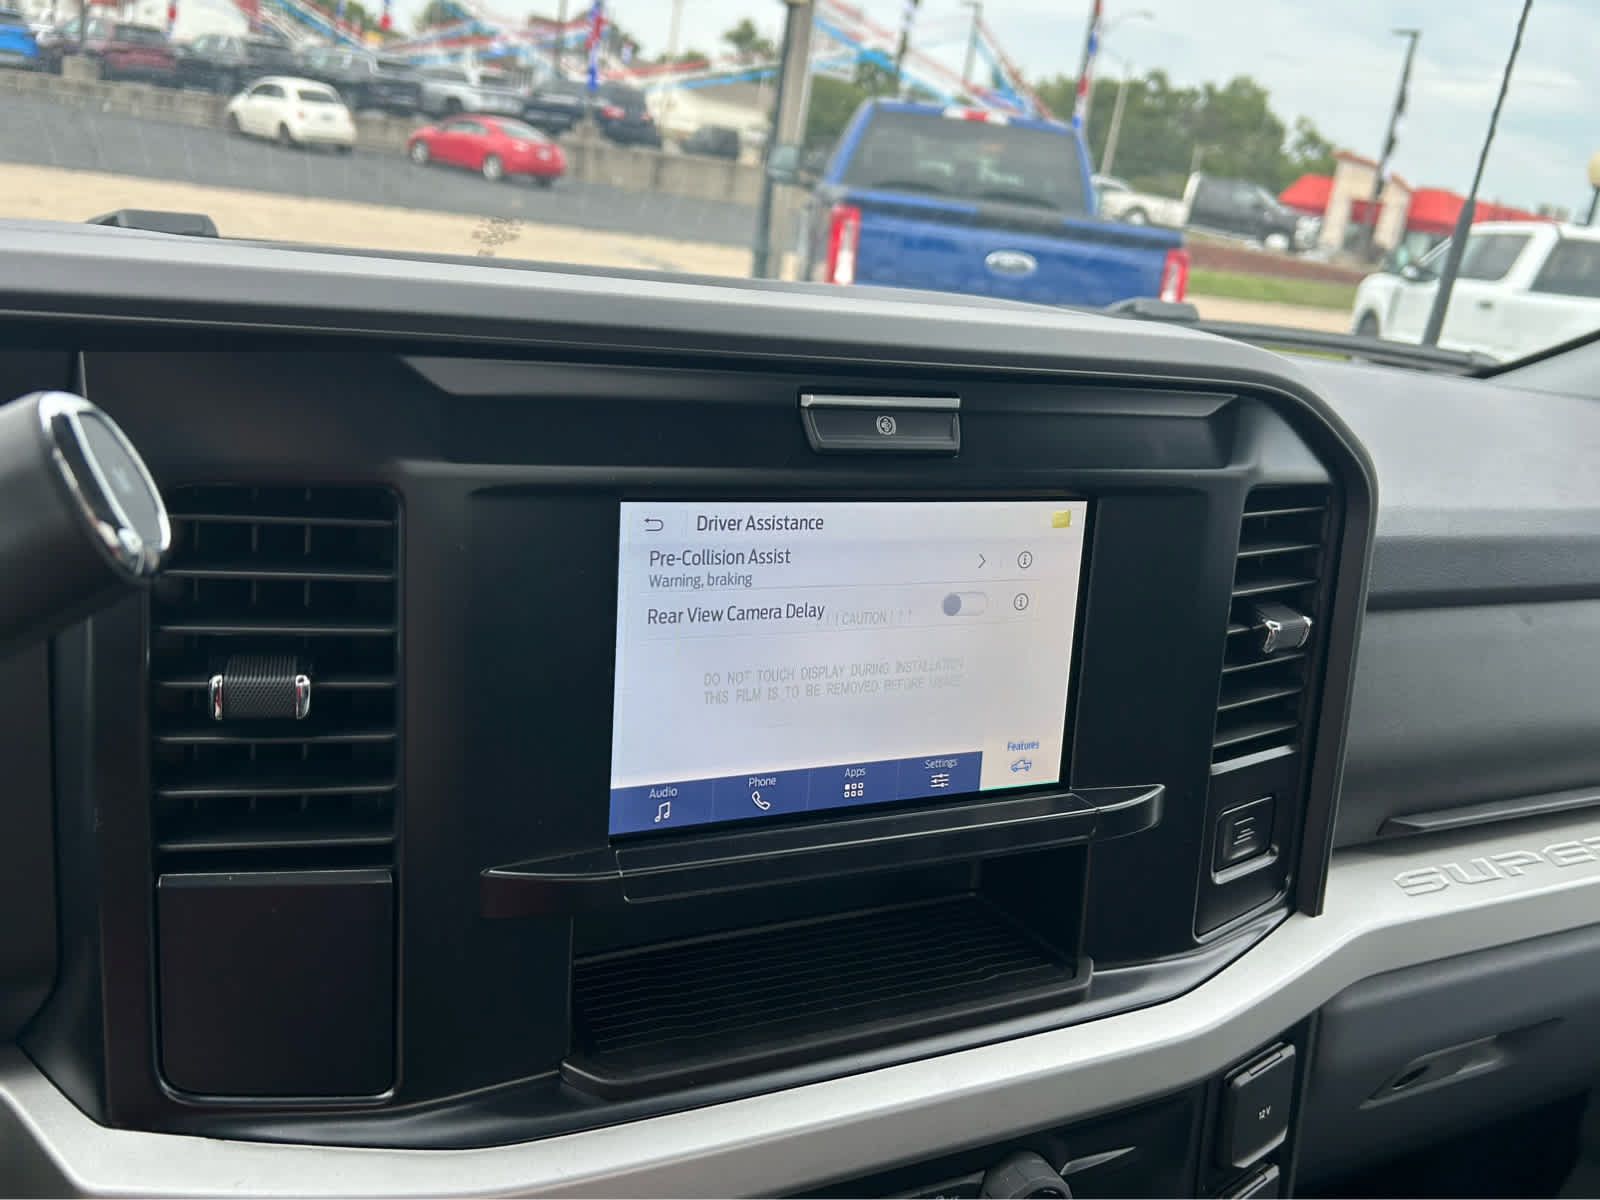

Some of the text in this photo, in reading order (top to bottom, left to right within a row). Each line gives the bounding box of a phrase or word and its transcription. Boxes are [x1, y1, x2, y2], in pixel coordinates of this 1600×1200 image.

[697, 514, 824, 532] Driver Assistance
[649, 548, 791, 567] Pre-Collision Assist
[648, 572, 753, 590] Warning, braking
[647, 602, 825, 625] Rear View Camera Delay
[703, 671, 721, 687] DO
[758, 668, 795, 682] TOUCH
[800, 664, 844, 681] DISPLAY
[703, 688, 729, 705] THIS
[736, 687, 761, 703] FILM
[784, 684, 799, 699] TO
[806, 683, 820, 697] BE
[826, 679, 879, 696] REMOVED
[1006, 740, 1040, 752] Features
[844, 766, 866, 779] Apps
[924, 757, 958, 770] Settings
[748, 776, 777, 788] Phone
[649, 786, 678, 799] Audio
